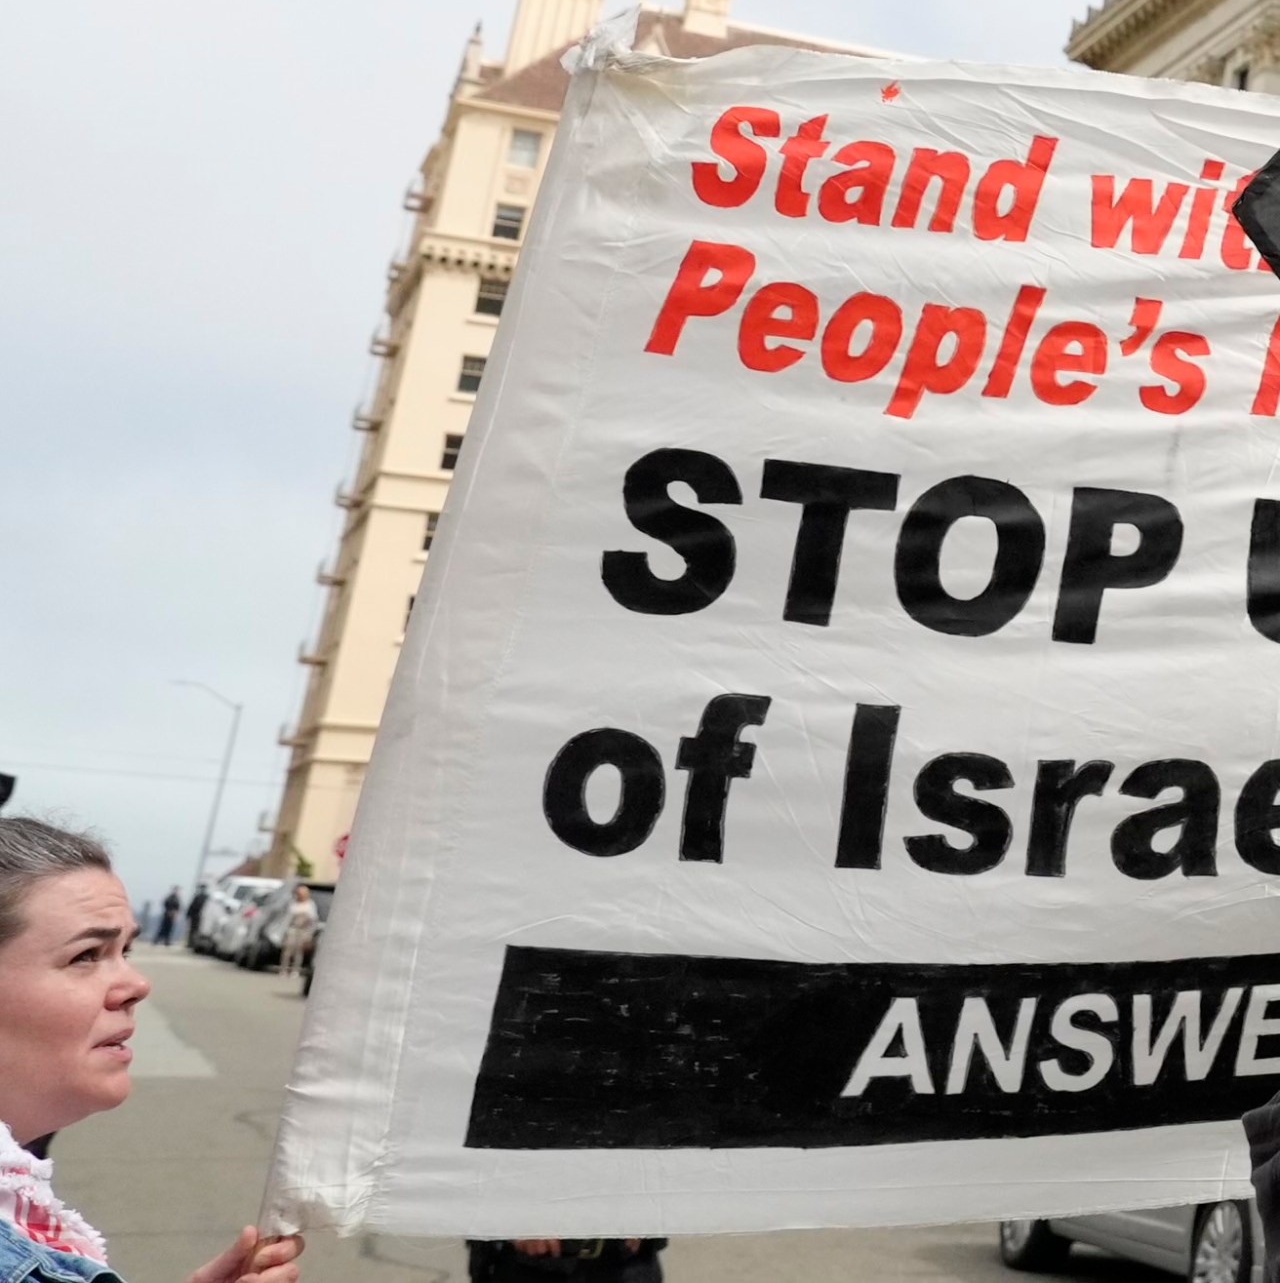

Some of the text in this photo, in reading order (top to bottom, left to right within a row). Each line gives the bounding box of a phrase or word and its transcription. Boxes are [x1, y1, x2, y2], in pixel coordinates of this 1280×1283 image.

[691, 105, 1274, 273] Stand wit
[645, 240, 1211, 419] People’s
[601, 447, 1184, 645] STOP
[542, 692, 772, 865] of
